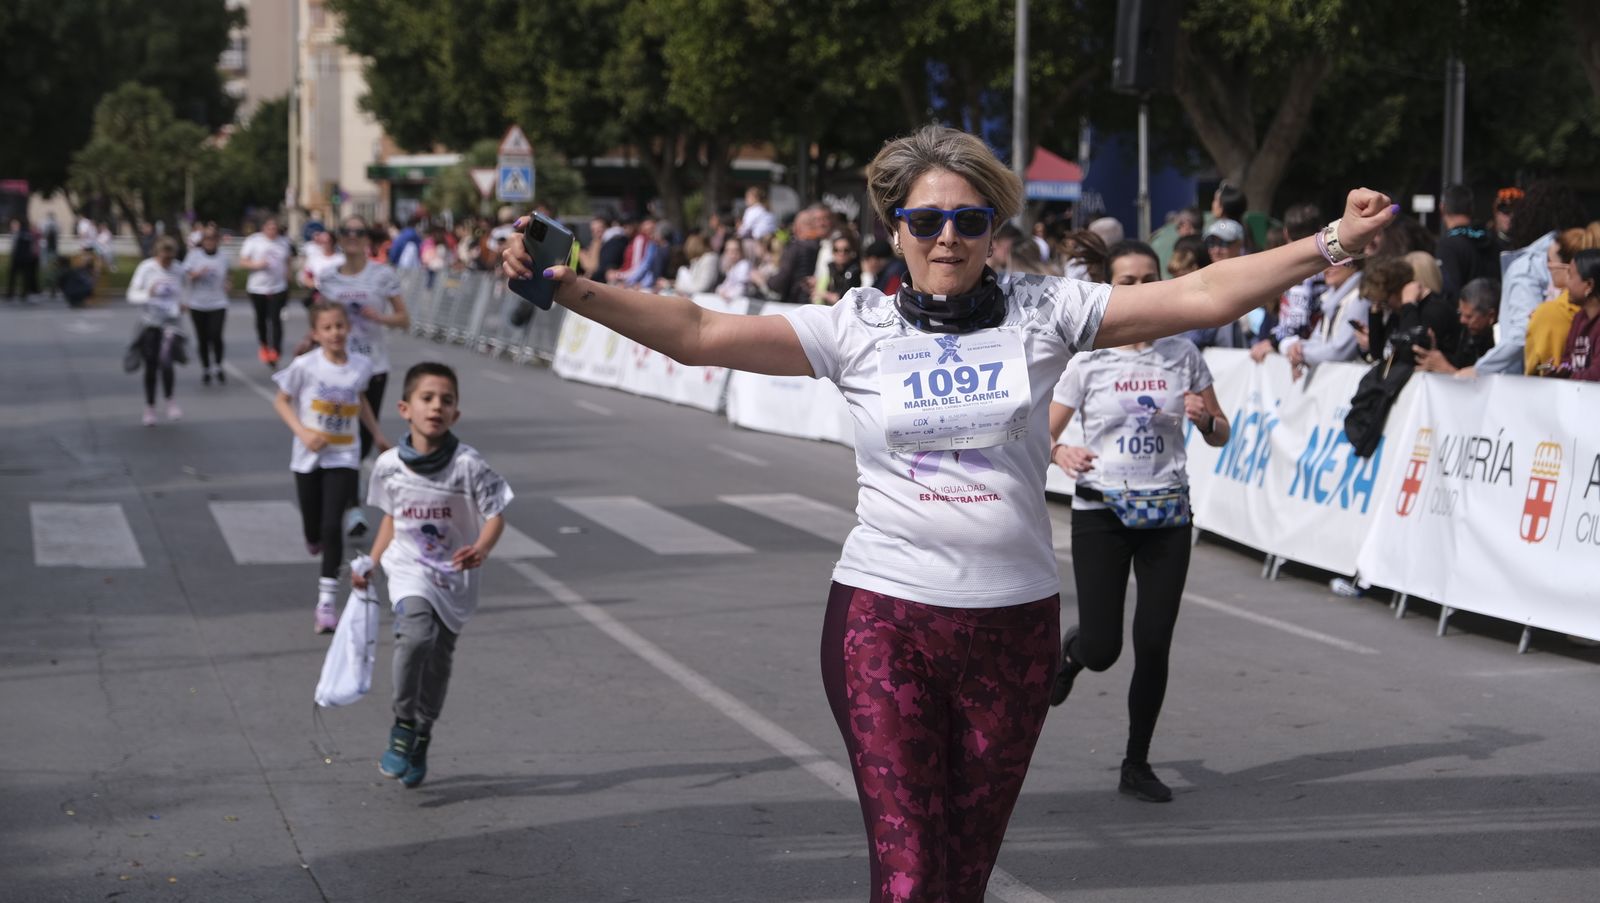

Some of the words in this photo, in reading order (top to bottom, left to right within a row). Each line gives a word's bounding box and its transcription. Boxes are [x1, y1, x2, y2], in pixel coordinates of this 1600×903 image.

[898, 351, 932, 361] MUJER
[903, 361, 1004, 400] 1097
[1115, 379, 1168, 392] MUJER
[904, 398, 938, 410] MARIA
[941, 395, 962, 405] DEL
[964, 389, 1009, 402] CARMEN
[1116, 435, 1164, 454] 1050
[1288, 425, 1386, 514] NEXA
[919, 493, 931, 501] ES
[933, 494, 974, 504] NUESTRA
[402, 506, 453, 519] MUJER
